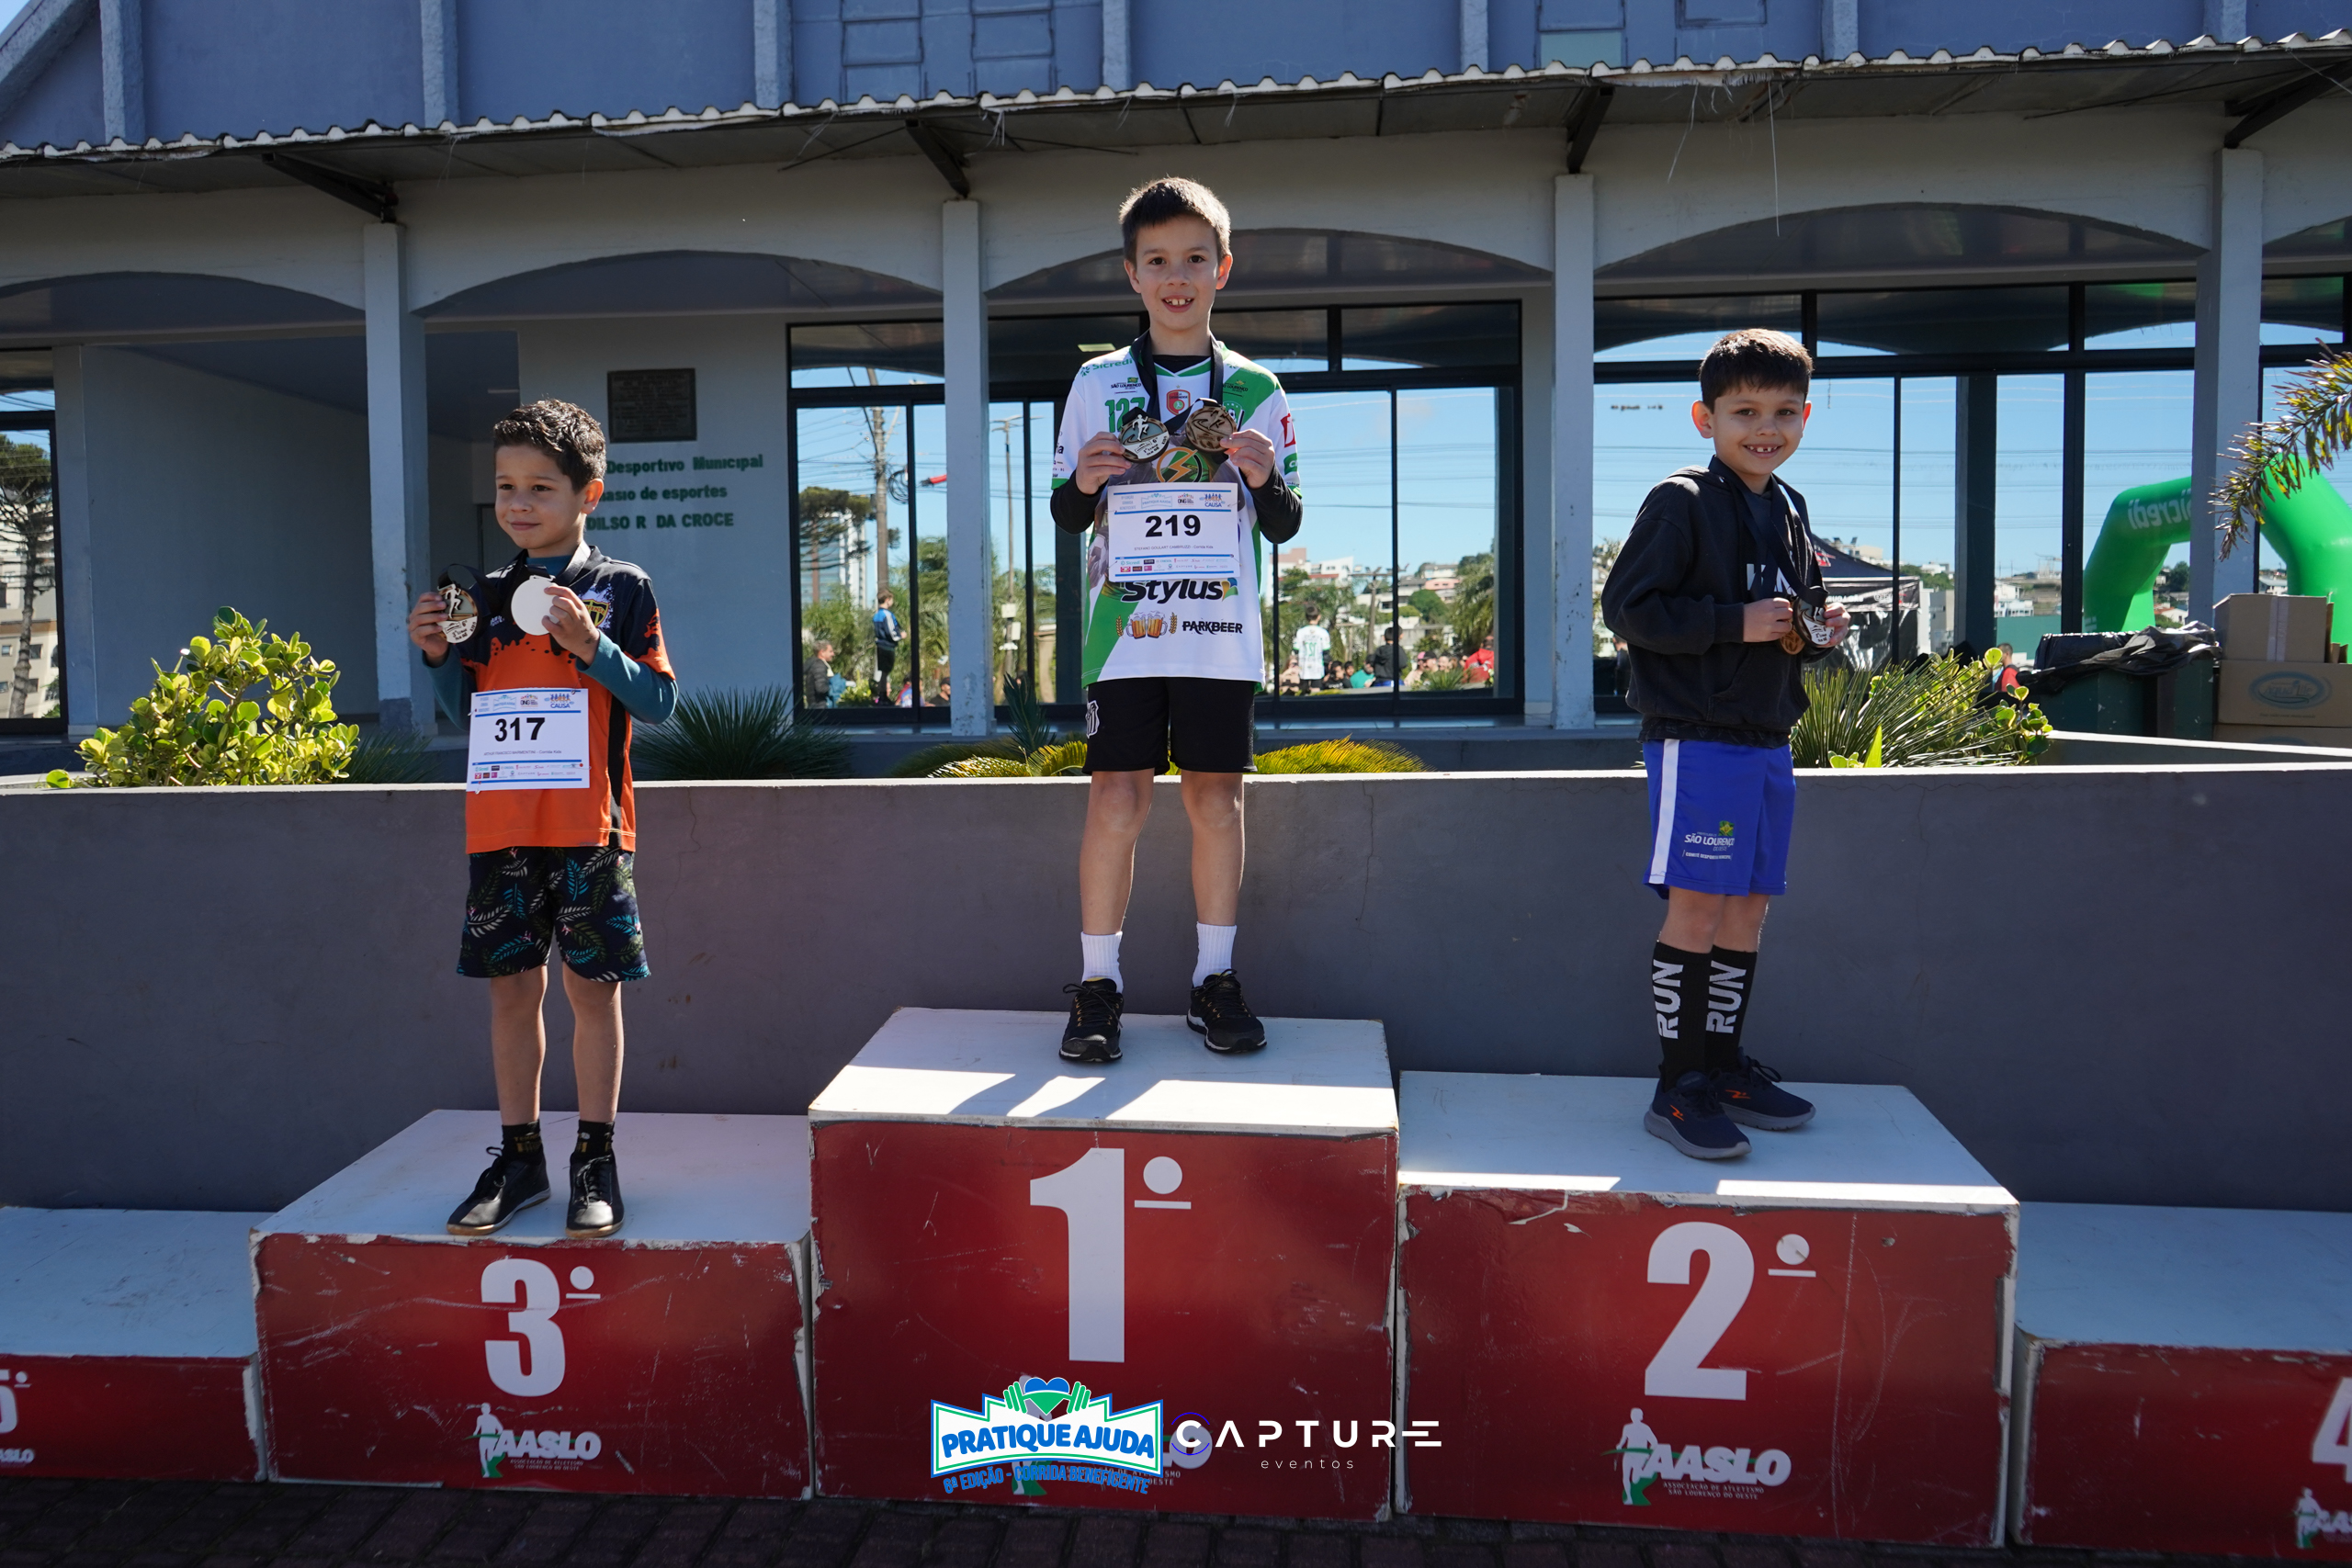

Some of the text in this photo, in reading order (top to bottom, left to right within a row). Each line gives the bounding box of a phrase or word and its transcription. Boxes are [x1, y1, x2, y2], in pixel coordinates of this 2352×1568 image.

[1092, 357, 1133, 370] Sicredi
[606, 454, 763, 476] Desportivo Municipal
[640, 486, 658, 500] de
[662, 485, 728, 502] esportes
[657, 514, 676, 528] DA
[682, 513, 733, 528] CROCE
[1145, 514, 1201, 537] 219
[1121, 578, 1224, 604] Stylus
[1182, 620, 1243, 635] PARKBEER
[494, 717, 545, 741] 317
[1684, 833, 1702, 843] SÃO
[1652, 959, 1684, 1040] RUN
[1705, 960, 1747, 1033] RUN
[492, 1429, 602, 1461] AASLO
[1639, 1443, 1792, 1486] AASLO
[1663, 1481, 1709, 1490] ASSOCIAÇÃO
[1723, 1484, 1765, 1494] ATLETISMO
[1684, 1489, 1721, 1498] LOURENÇO
